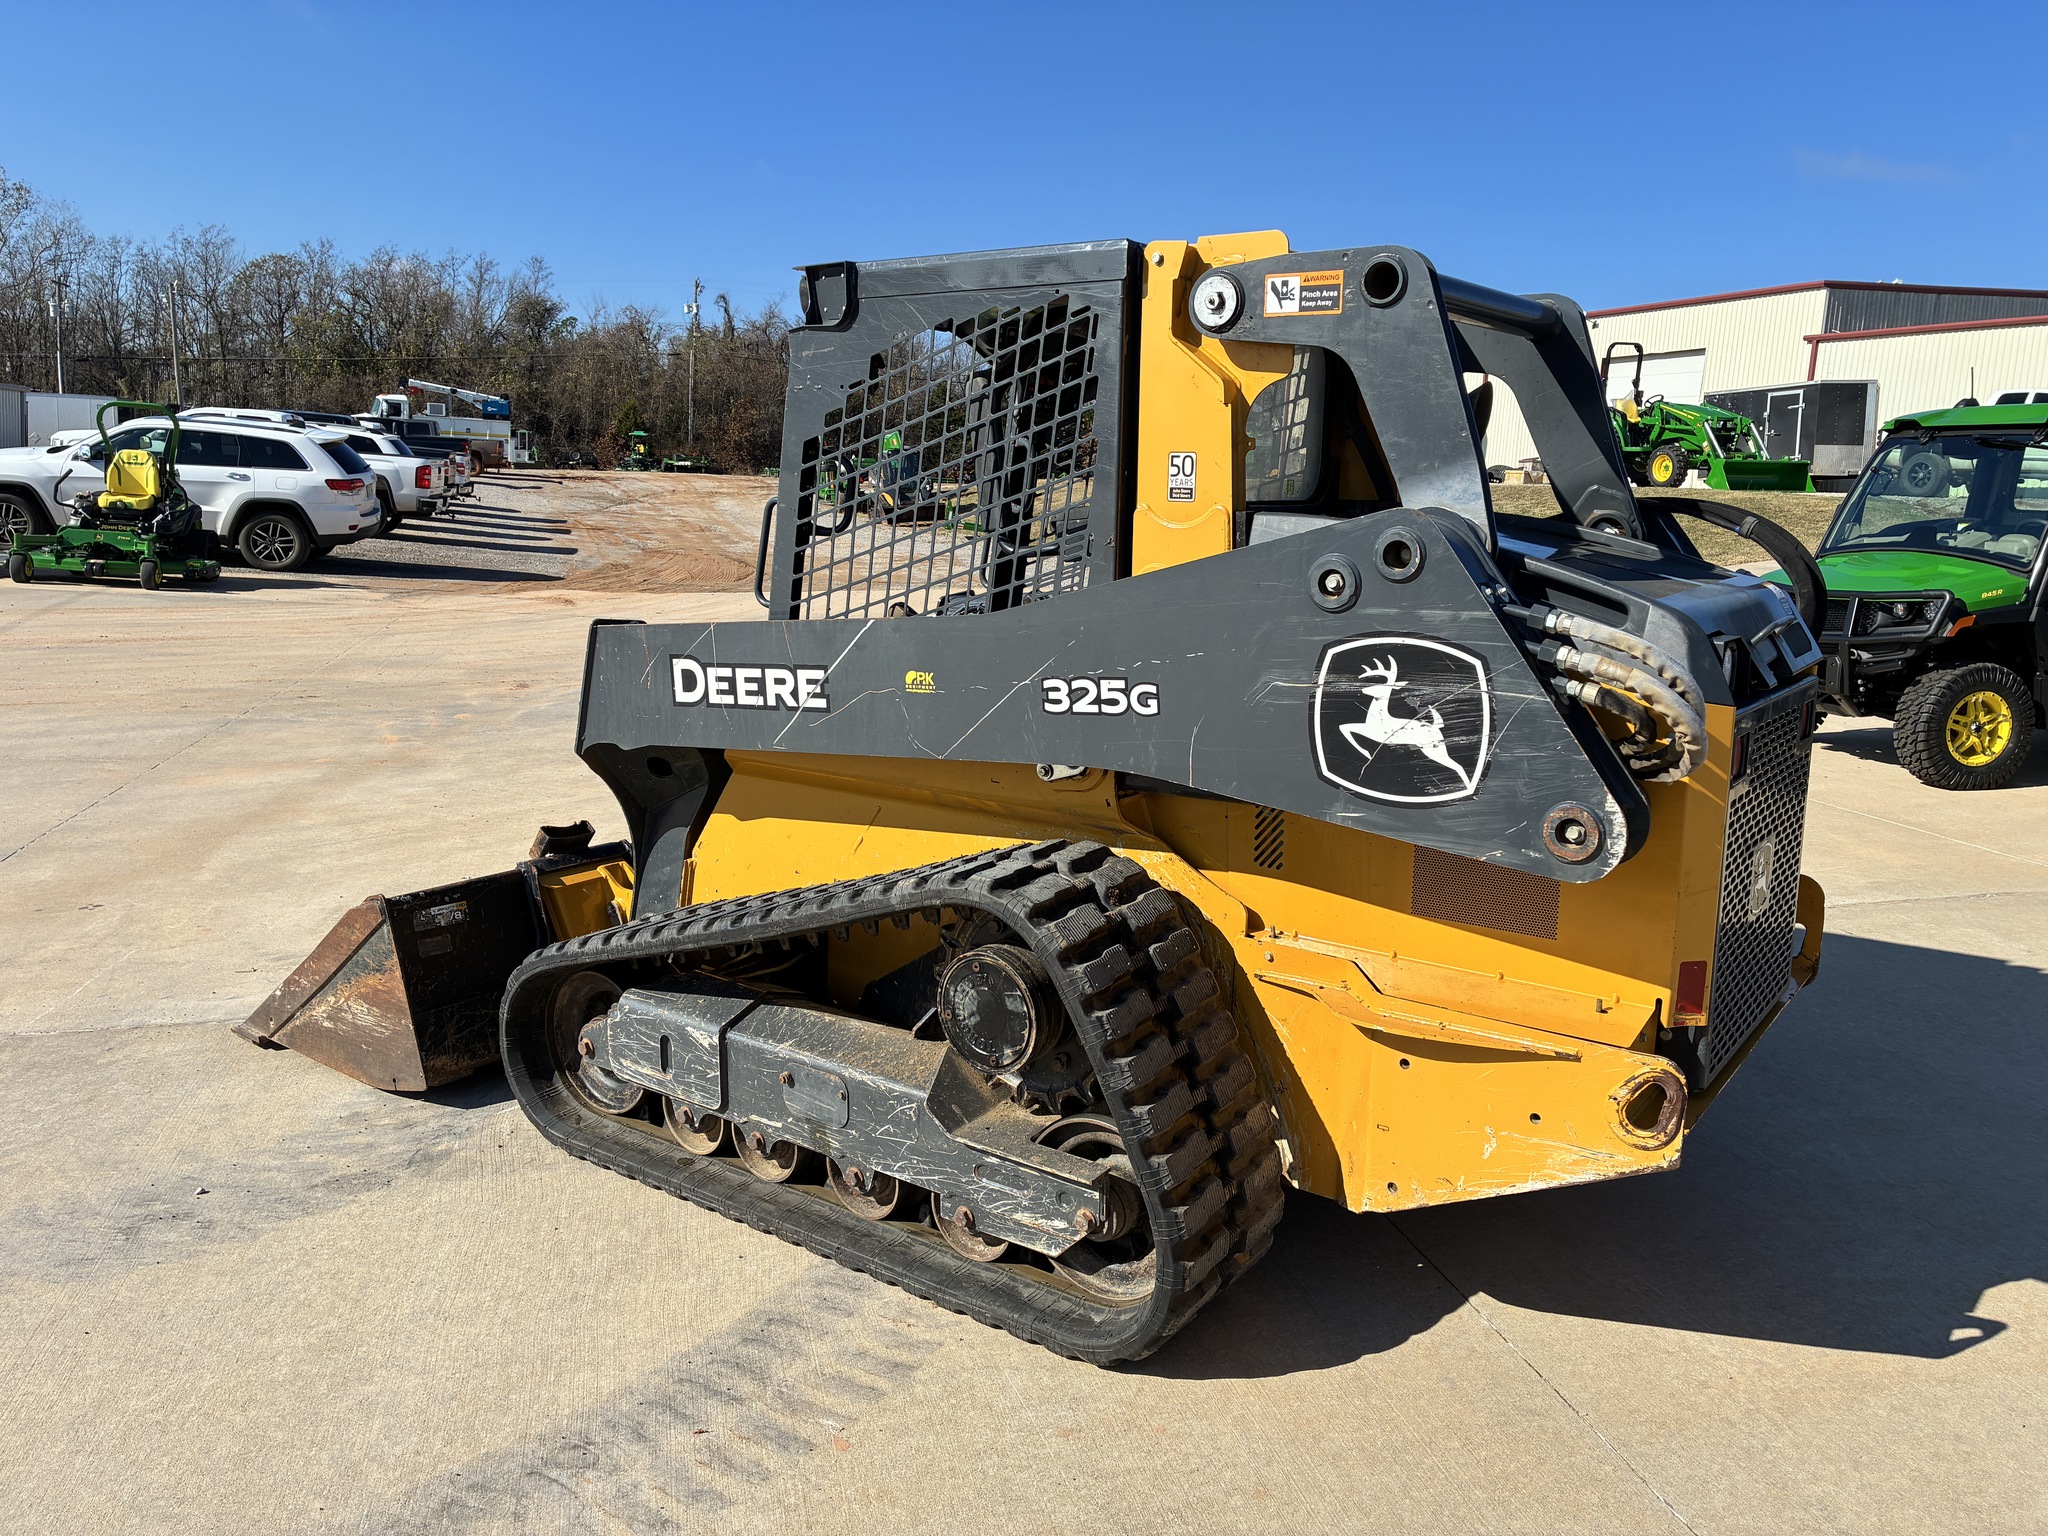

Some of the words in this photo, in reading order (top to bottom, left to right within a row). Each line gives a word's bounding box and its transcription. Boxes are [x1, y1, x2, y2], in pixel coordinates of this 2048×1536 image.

[1310, 274, 1340, 282] WARNING
[1301, 290, 1321, 298] Pinch
[1170, 454, 1194, 477] 50
[1169, 478, 1194, 487] YEARS
[671, 657, 829, 710] DEERE
[1041, 677, 1160, 716] 325G
